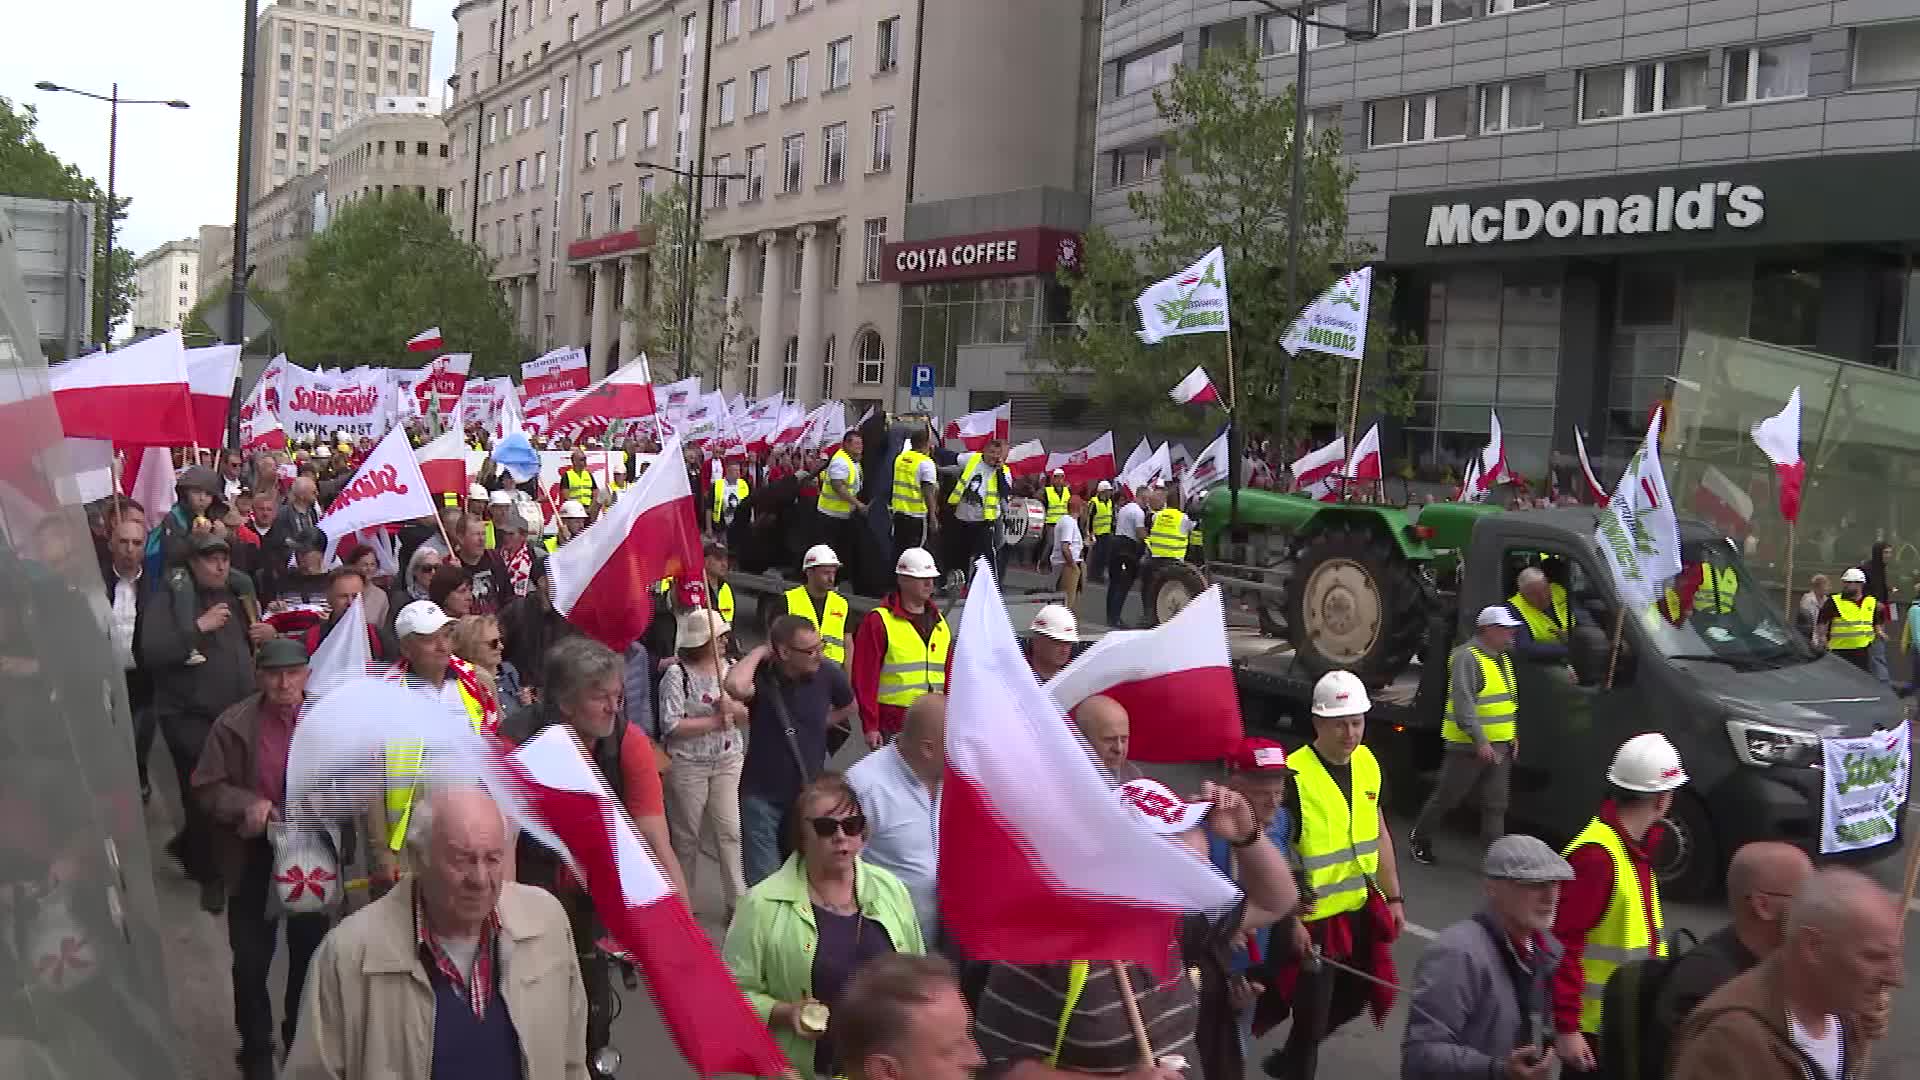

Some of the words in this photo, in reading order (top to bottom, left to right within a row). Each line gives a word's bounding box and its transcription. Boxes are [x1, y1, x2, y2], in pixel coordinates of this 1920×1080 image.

[1425, 181, 1765, 246] McDonald's
[896, 248, 948, 272] COSTA
[951, 240, 1018, 267] COFFEE
[916, 366, 930, 387] P
[294, 421, 328, 436] KWK
[337, 422, 373, 436] PIAST
